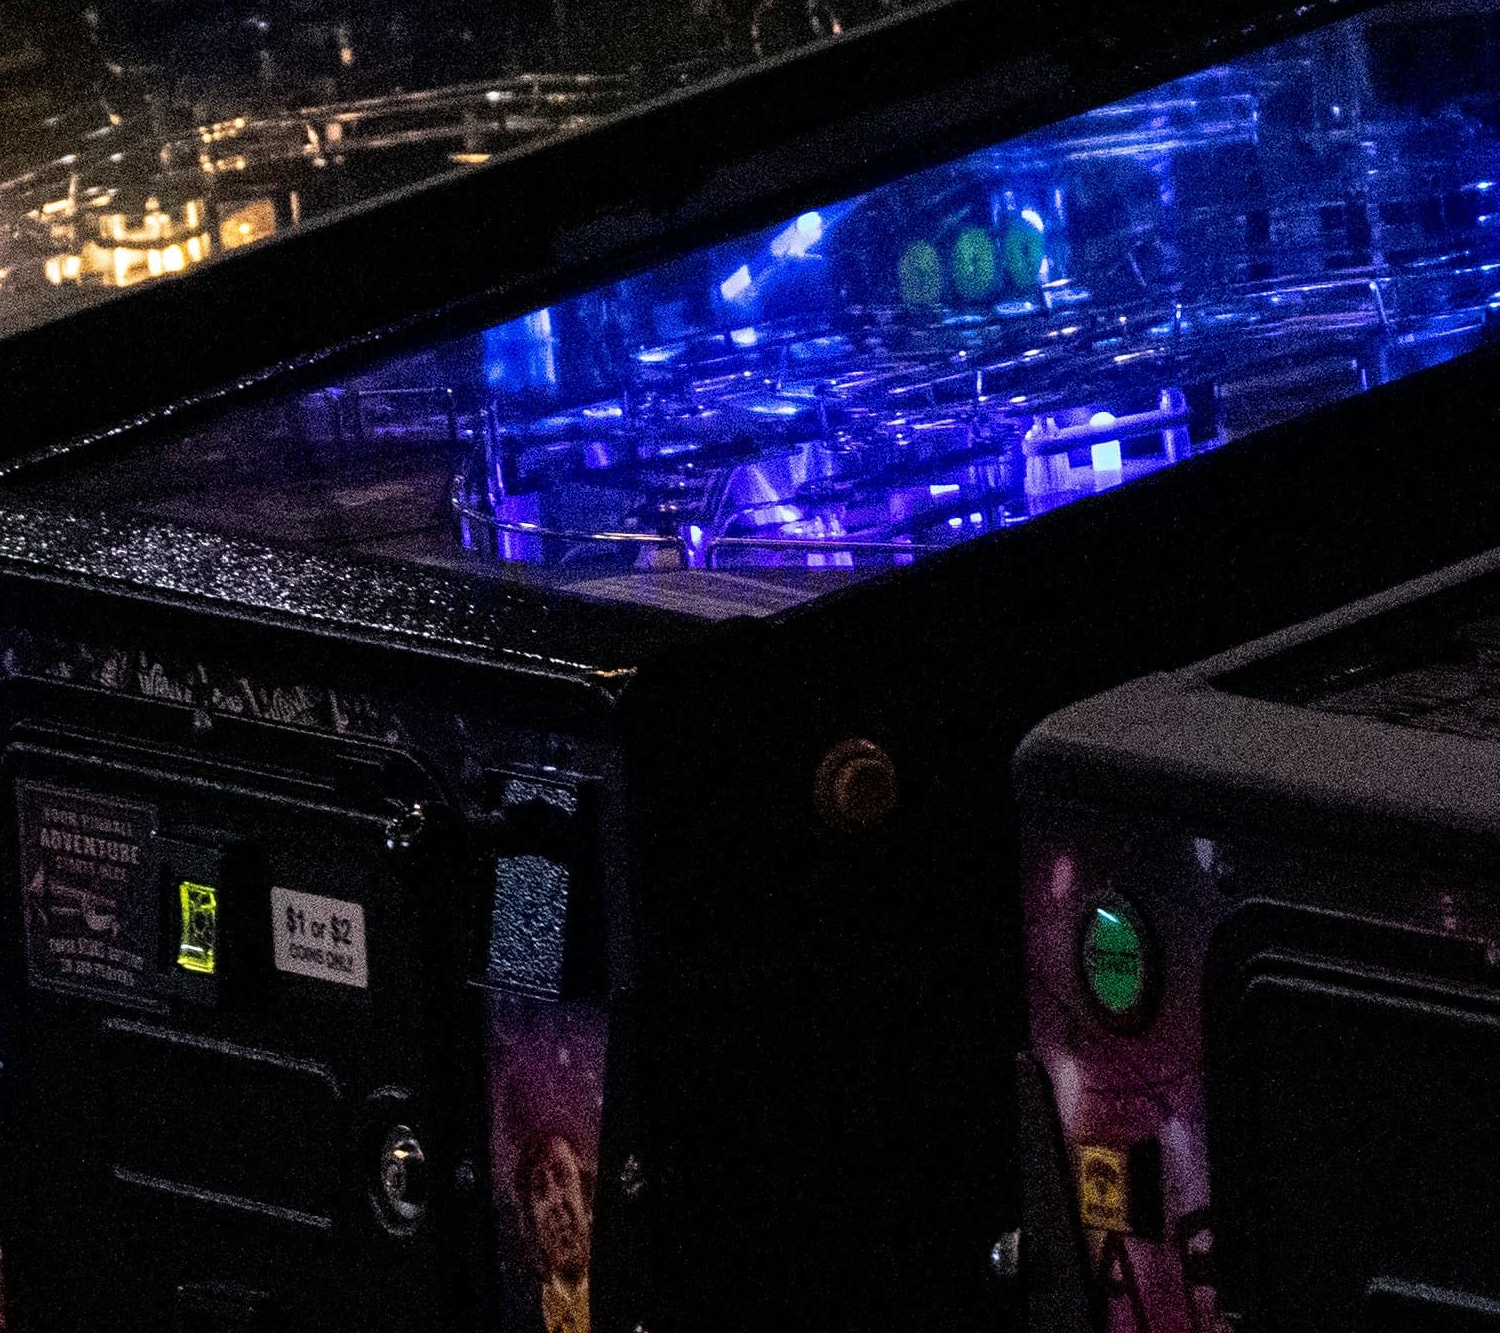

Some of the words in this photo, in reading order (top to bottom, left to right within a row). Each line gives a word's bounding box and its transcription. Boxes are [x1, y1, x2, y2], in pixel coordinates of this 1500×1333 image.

[40, 826, 141, 866] ADVENTURE
[286, 904, 306, 937] $1
[310, 921, 326, 939] or
[330, 913, 352, 947] $2
